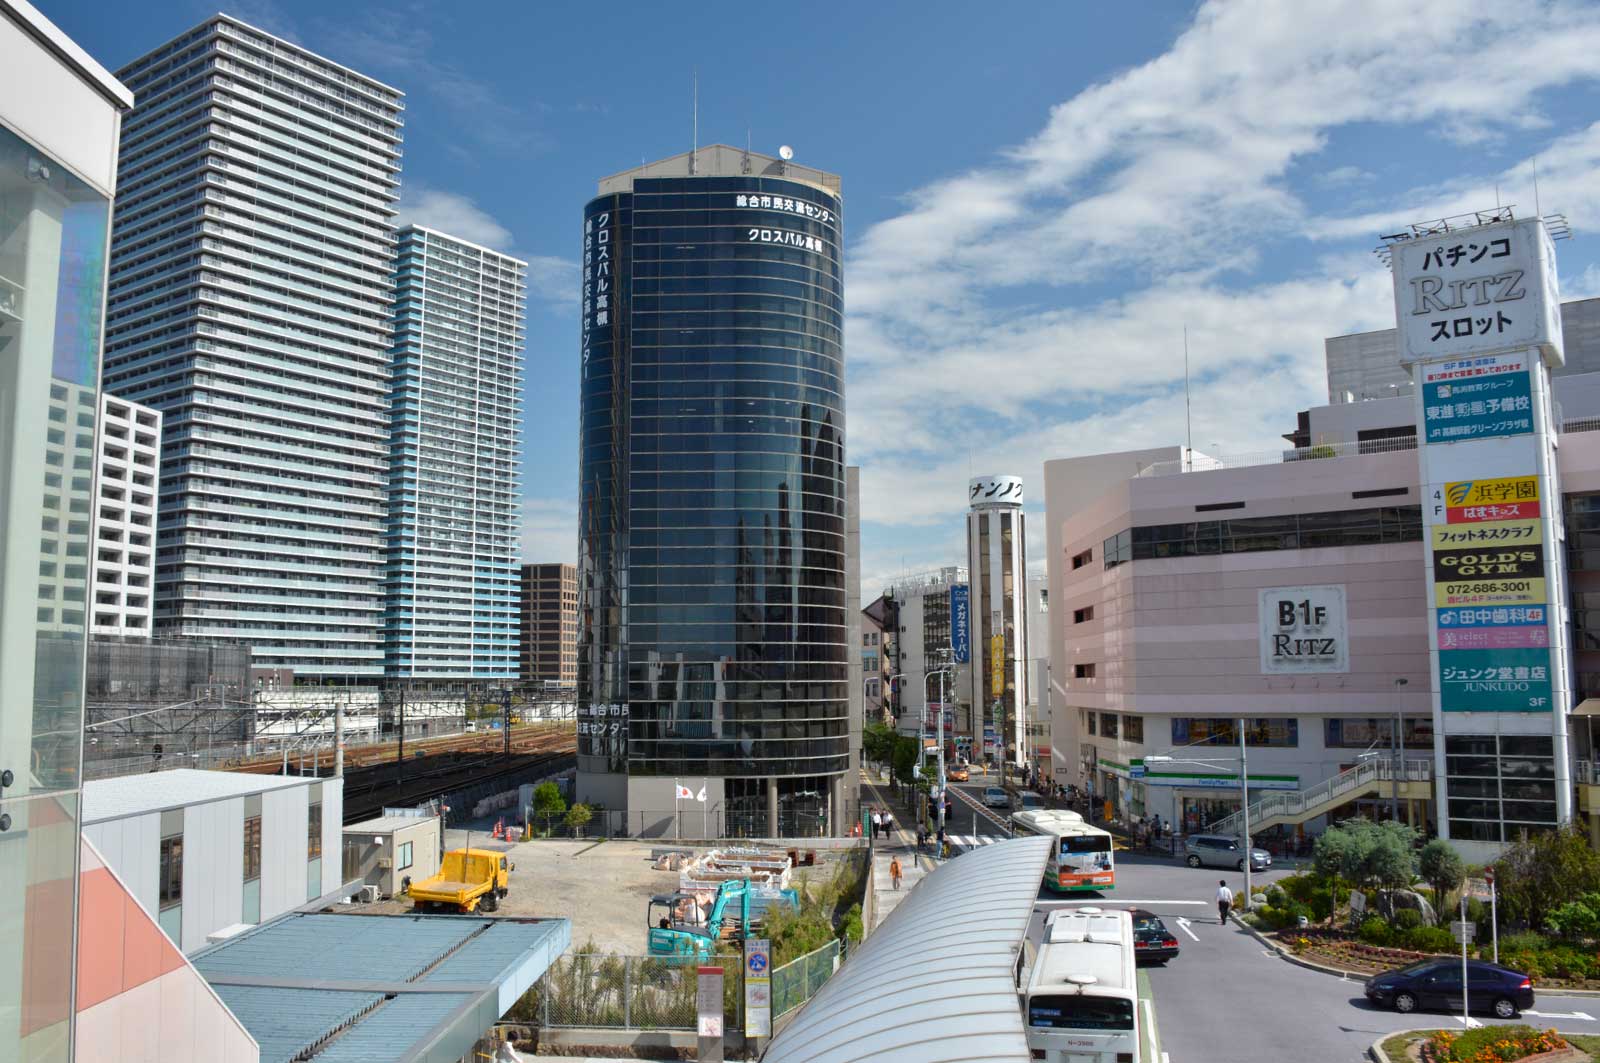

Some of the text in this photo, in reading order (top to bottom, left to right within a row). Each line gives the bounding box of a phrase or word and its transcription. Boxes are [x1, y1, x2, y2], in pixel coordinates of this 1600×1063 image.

[736, 195, 835, 222] 総合市民交流センター
[748, 229, 822, 253] クロスパル高槻
[1422, 238, 1511, 271] パチンコ
[597, 213, 609, 326] クロスパル高槻
[1410, 270, 1526, 316] RITZ
[1431, 311, 1513, 341] スロット
[1426, 395, 1529, 420] 東進衛星予備校
[1475, 481, 1536, 502] 浜学園
[1438, 525, 1534, 543] フィットネスクラブ
[1440, 552, 1537, 566] GOLD'S
[1457, 564, 1520, 575] GYM
[1446, 582, 1531, 595] 072-686-3001
[1460, 608, 1526, 625] 田中歯科
[957, 603, 967, 659] メガネスーパー
[1272, 634, 1336, 656] RITZ
[1443, 666, 1546, 680] ジュンク堂書店
[1463, 682, 1530, 692] JUNKUDO
[1528, 697, 1547, 707] 3F
